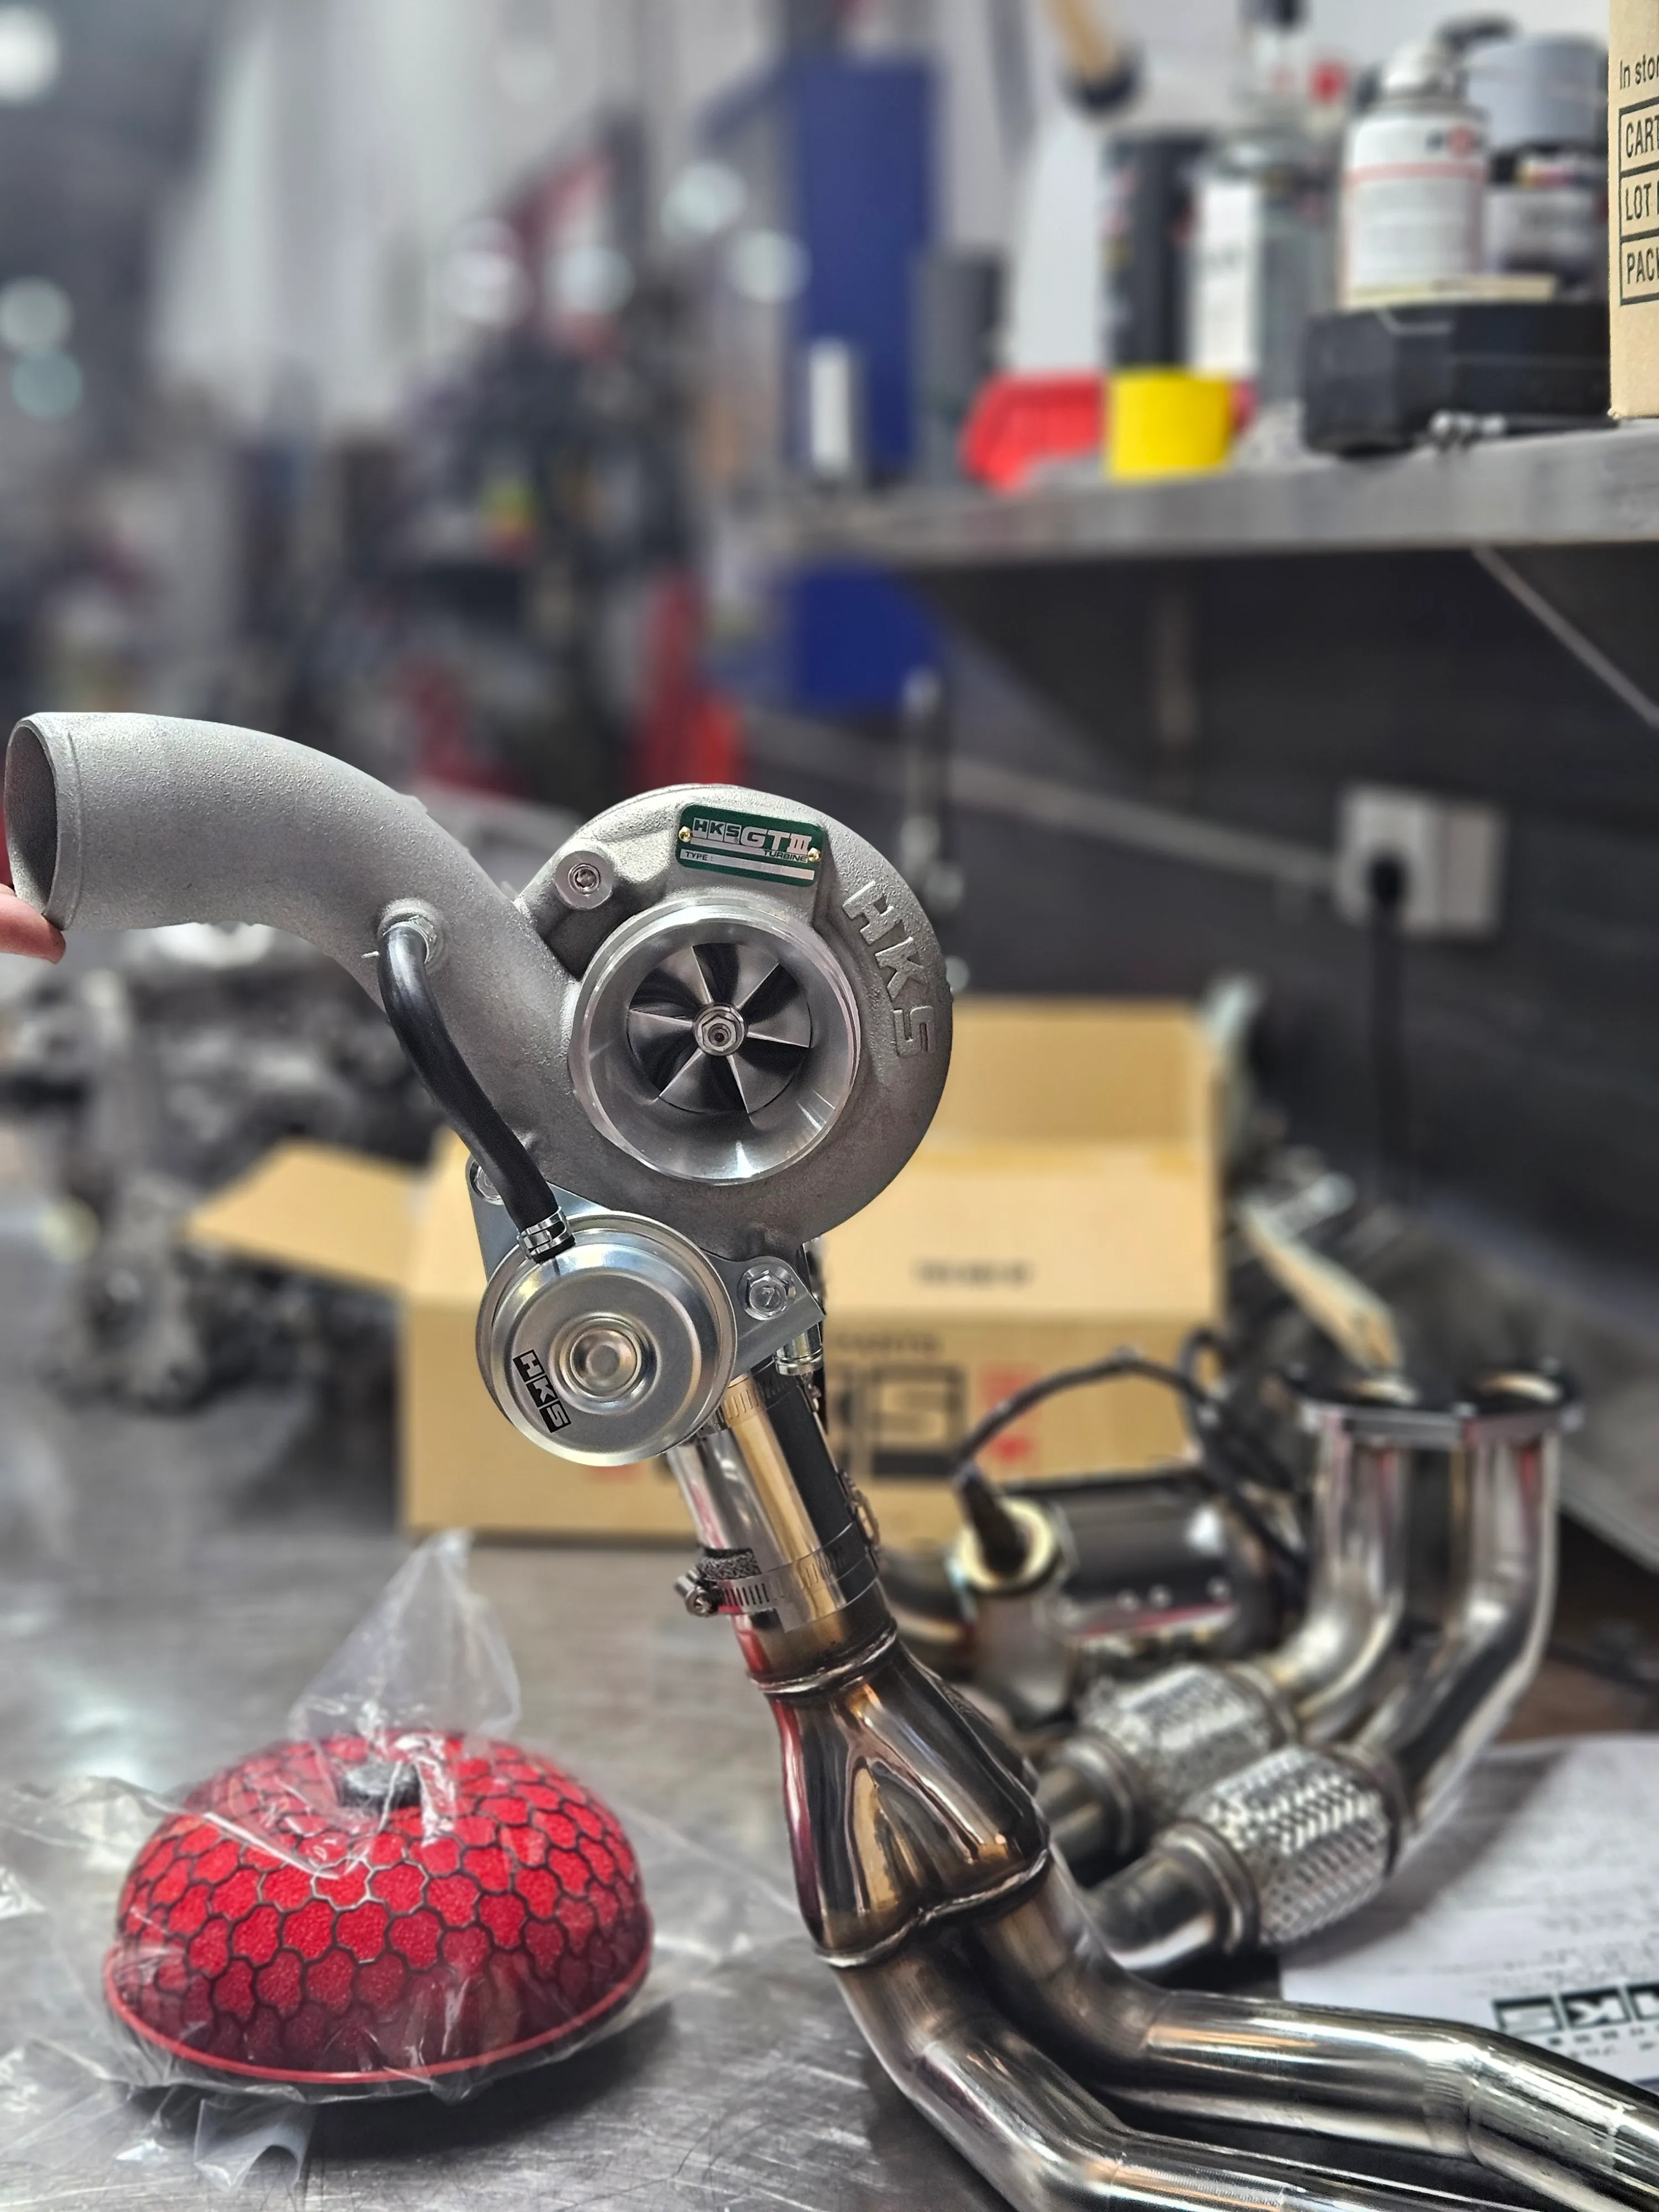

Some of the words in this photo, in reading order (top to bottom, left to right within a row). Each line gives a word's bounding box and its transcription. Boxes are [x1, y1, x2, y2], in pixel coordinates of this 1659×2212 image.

[1620, 59, 1631, 90] In
[1626, 182, 1652, 221] LOT
[692, 818, 742, 842] HKS
[763, 849, 808, 862] TURBINE
[842, 880, 935, 1057] HKS
[513, 1349, 571, 1433] HKS
